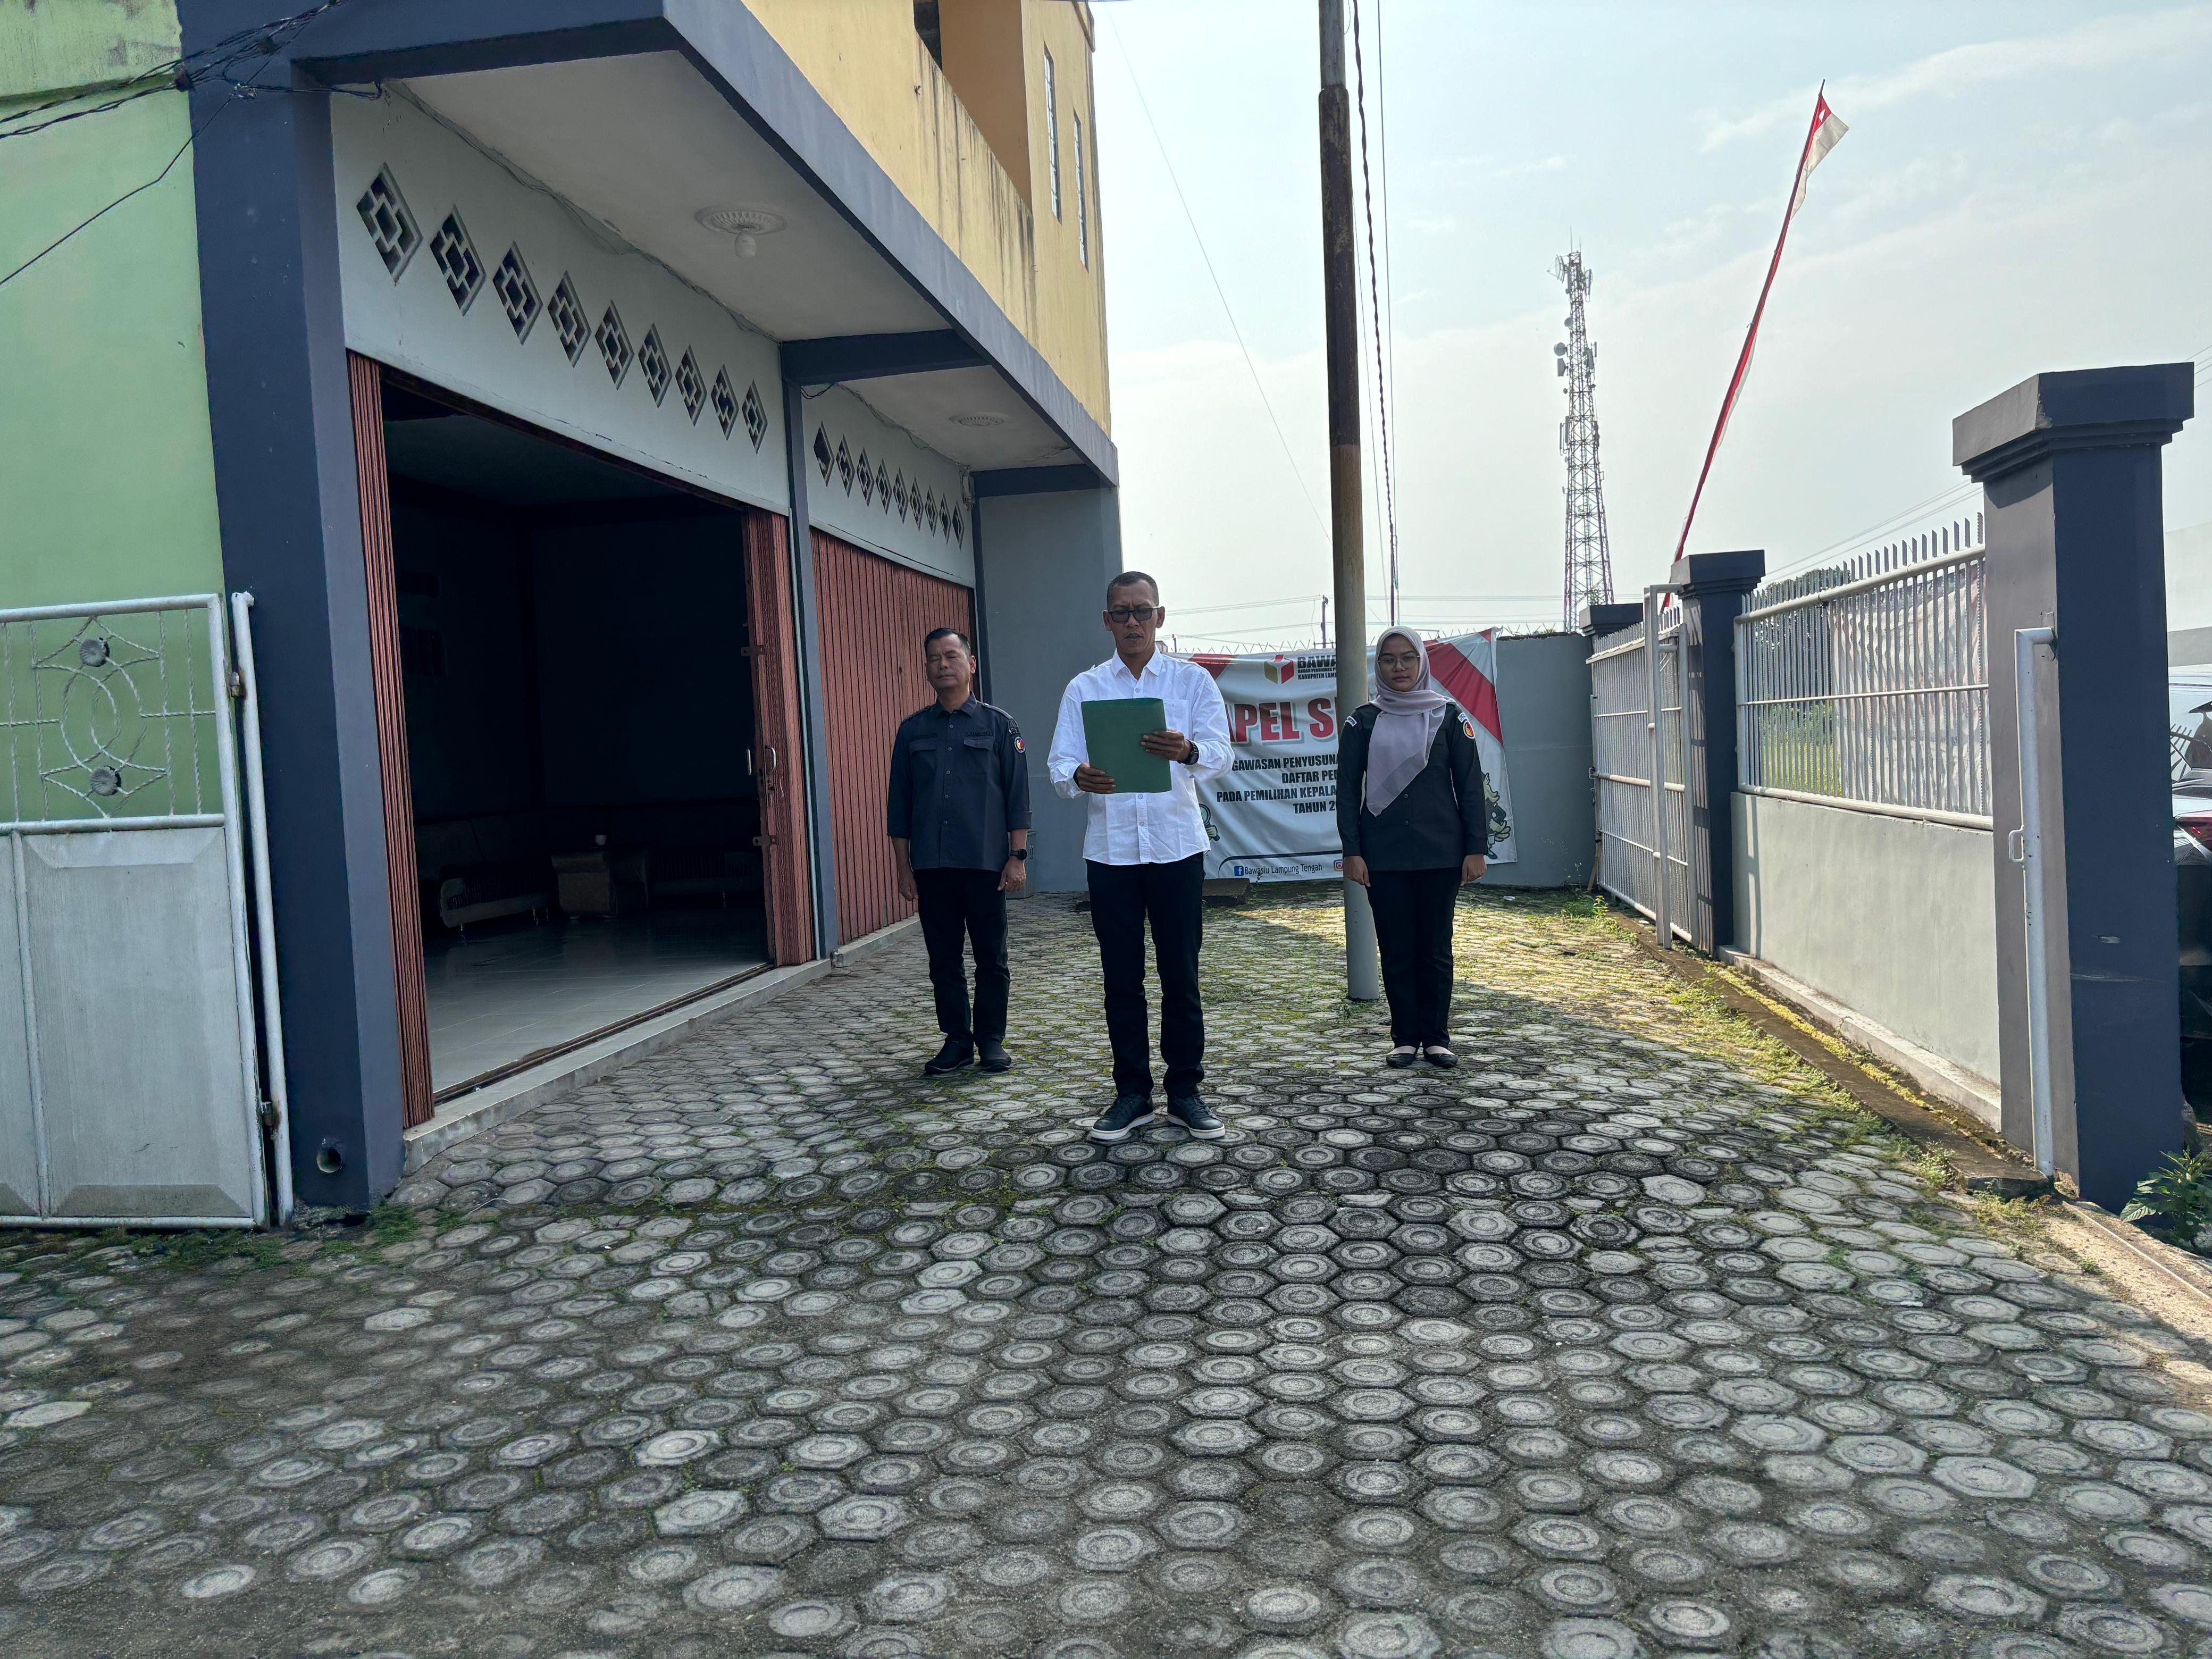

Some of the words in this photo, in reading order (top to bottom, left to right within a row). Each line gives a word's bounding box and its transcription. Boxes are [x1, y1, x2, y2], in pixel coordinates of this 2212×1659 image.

[1307, 697, 1337, 739] S
[1232, 758, 1281, 771] GAWASAN
[1282, 771, 1319, 784] DAFTAR
[1217, 791, 1242, 802] PADA
[1244, 788, 1297, 801] PEMILIHAN
[1300, 785, 1336, 798] KEPALA
[1293, 801, 1327, 814] TAHUN
[1245, 866, 1269, 874] Bawaslu
[1271, 866, 1299, 875] Lampung
[1300, 863, 1322, 873] Tengah
